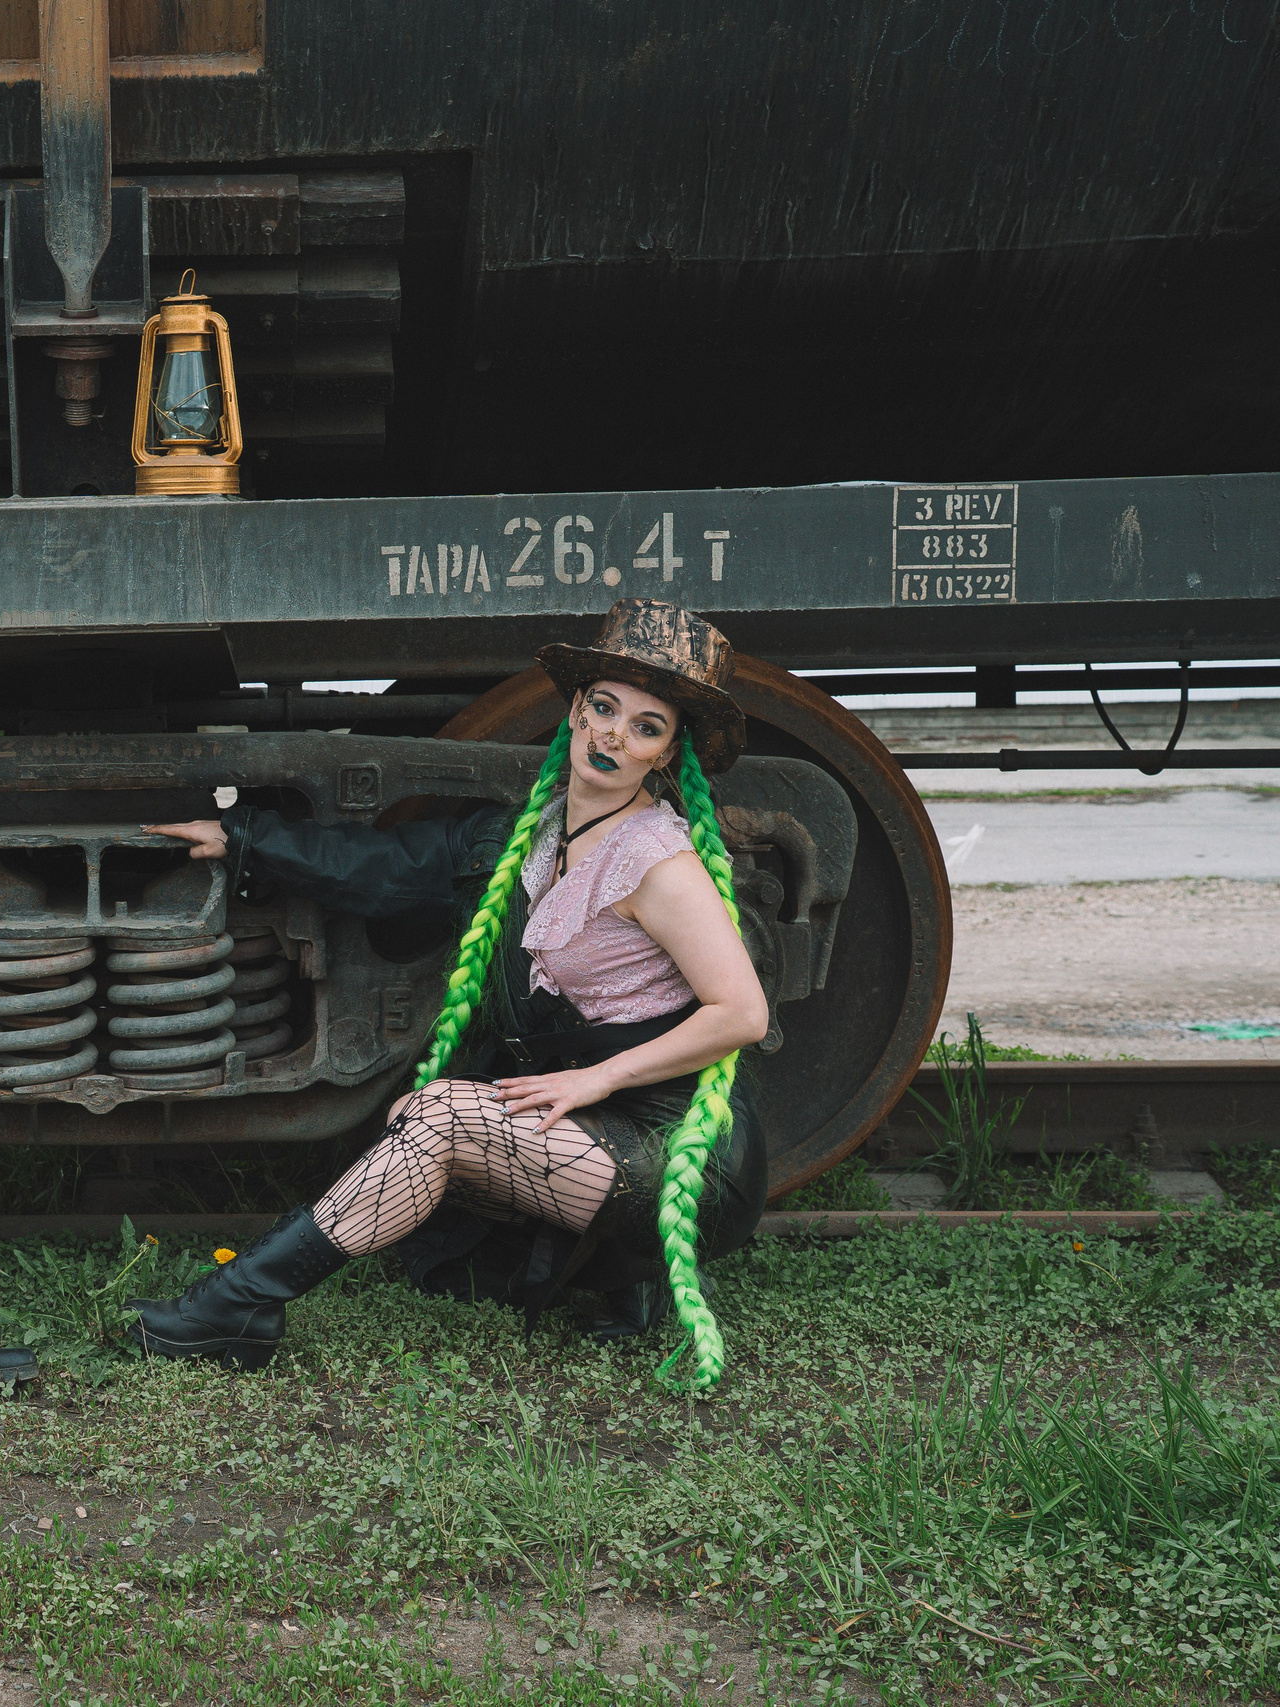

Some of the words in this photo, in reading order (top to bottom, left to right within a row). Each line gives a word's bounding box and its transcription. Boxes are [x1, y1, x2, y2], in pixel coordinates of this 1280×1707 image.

[915, 497, 933, 520] 3
[945, 493, 1002, 520] REV
[381, 543, 491, 596] ТАРА
[503, 512, 683, 587] 26.4
[922, 534, 988, 558] 883
